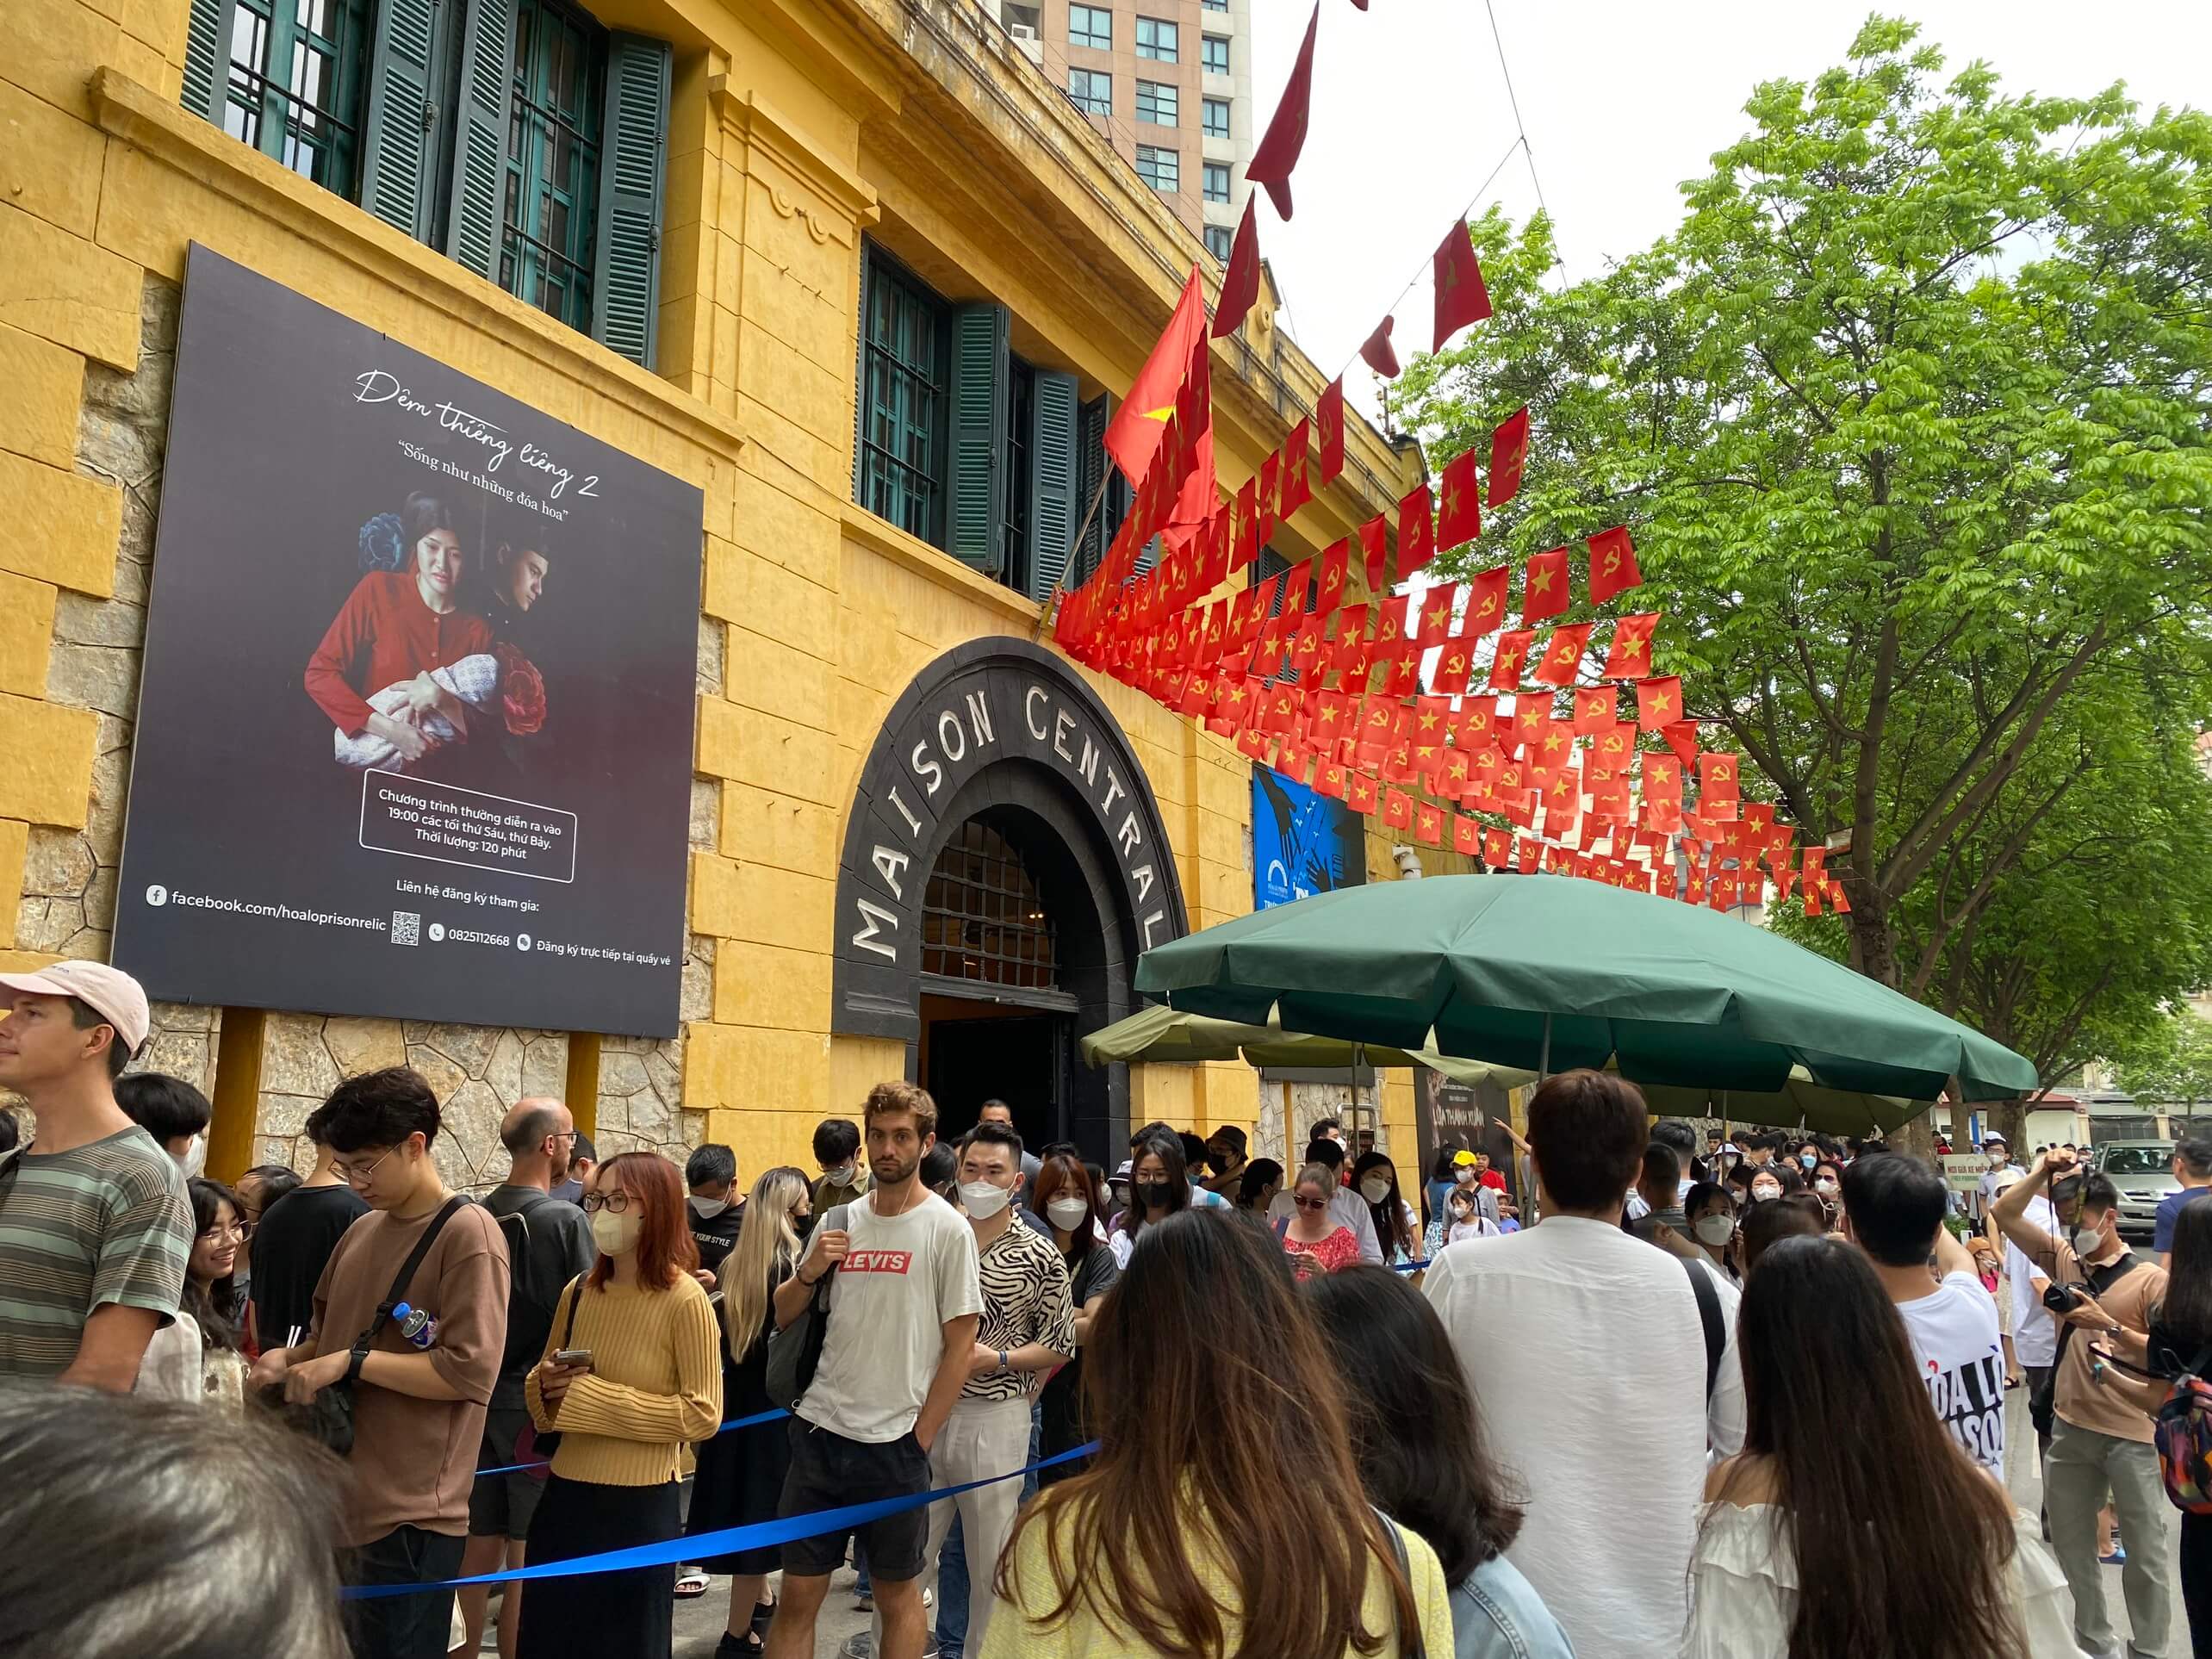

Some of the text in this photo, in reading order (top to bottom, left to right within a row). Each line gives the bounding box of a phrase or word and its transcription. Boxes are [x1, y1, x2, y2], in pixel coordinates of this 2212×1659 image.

[352, 369, 600, 499] Đêm thiêng liêng 2
[442, 462, 469, 481] như
[472, 474, 514, 503] những
[517, 488, 538, 509] đóa
[379, 788, 562, 836] Chương trình thường diễn ra vào
[388, 806, 552, 850] 19:00 các tối thứ Sáu, thứ Bảy.
[852, 686, 1165, 964] MAISON CENTRAL
[415, 828, 527, 860] Thời lượng: 120 phút
[171, 890, 387, 931] facebook.com/hoaloprisonrelic
[396, 879, 540, 912] Liên hệ đăng ký tham gia:
[448, 929, 510, 947] 0825112668
[536, 940, 565, 955] Đăng
[567, 943, 578, 957] ký
[581, 946, 600, 959] trực
[602, 948, 621, 962] tiếp
[623, 951, 635, 964] tại
[660, 955, 671, 966] vé
[696, 1233, 711, 1242] YOUR
[711, 1236, 730, 1247] STYLE
[843, 1253, 905, 1270] LEVI'S
